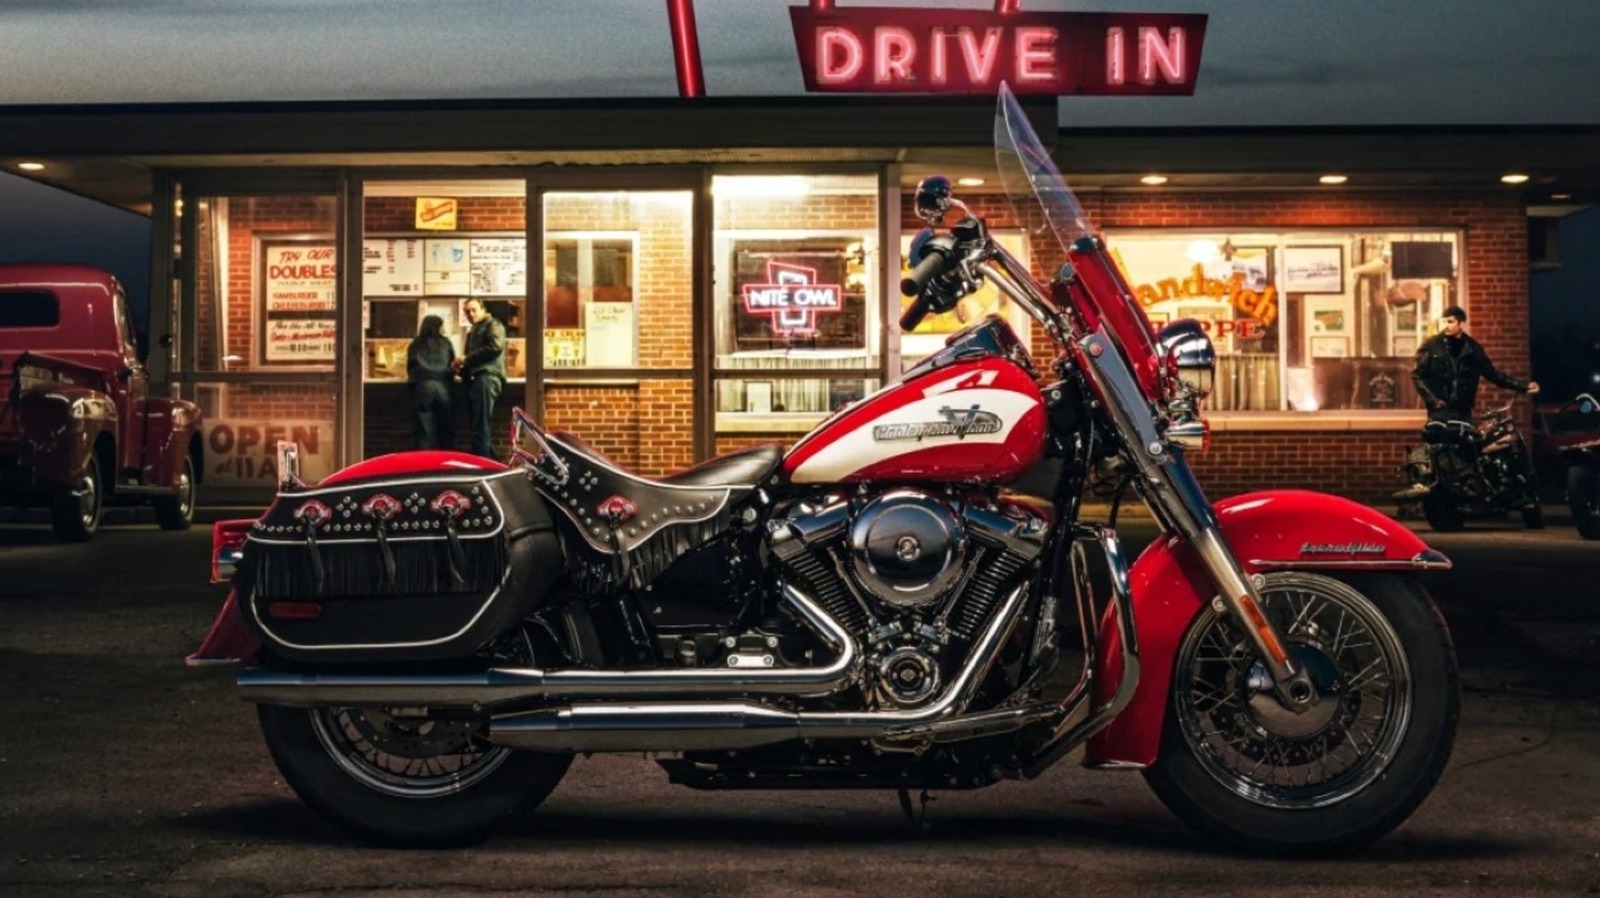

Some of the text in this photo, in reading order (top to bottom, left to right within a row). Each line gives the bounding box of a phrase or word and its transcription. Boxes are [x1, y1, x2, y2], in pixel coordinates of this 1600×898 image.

[816, 26, 1187, 85] DRIVE IN
[279, 248, 335, 264] TRY OUR
[750, 288, 837, 307] NITE OWL
[1136, 263, 1278, 326] andwich
[209, 424, 319, 455] OPEN
